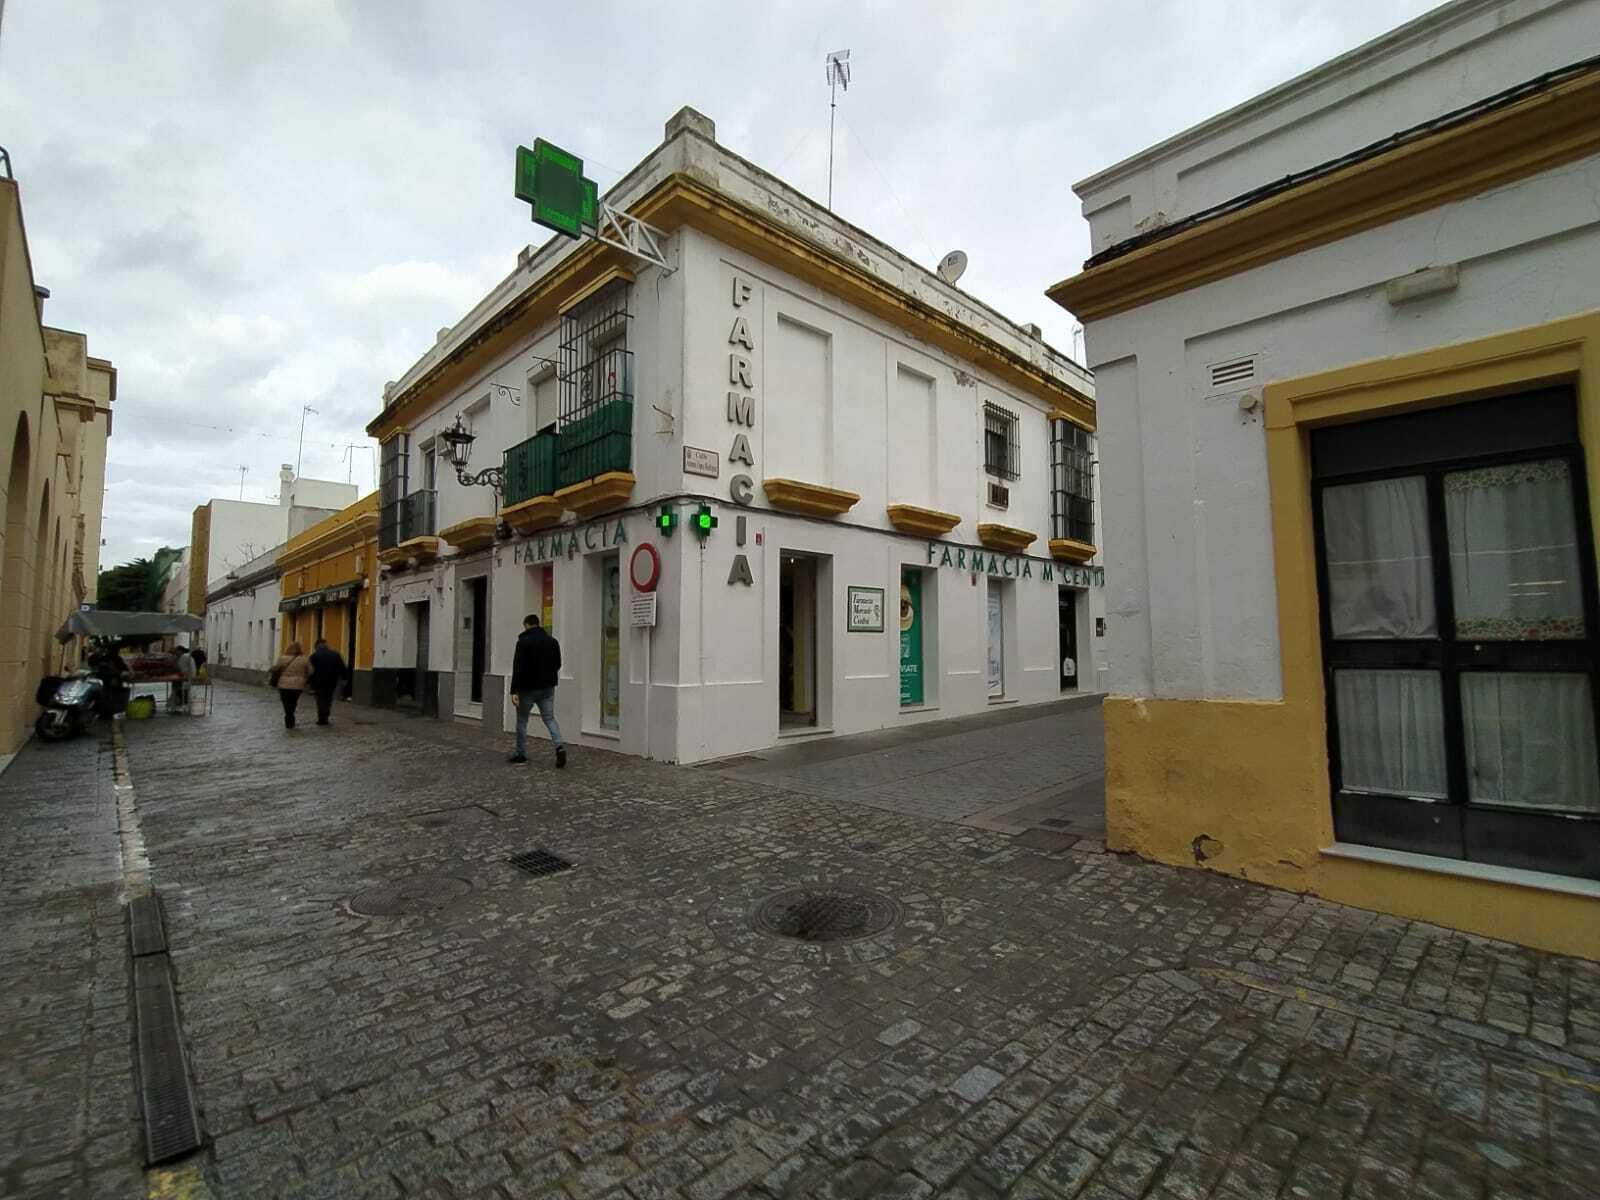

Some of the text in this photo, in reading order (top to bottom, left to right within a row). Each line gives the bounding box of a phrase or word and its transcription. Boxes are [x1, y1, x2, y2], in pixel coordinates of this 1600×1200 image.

[727, 276, 755, 585] FARMACIA
[513, 519, 627, 565] FARMACIA
[928, 541, 1032, 578] FARMACIA
